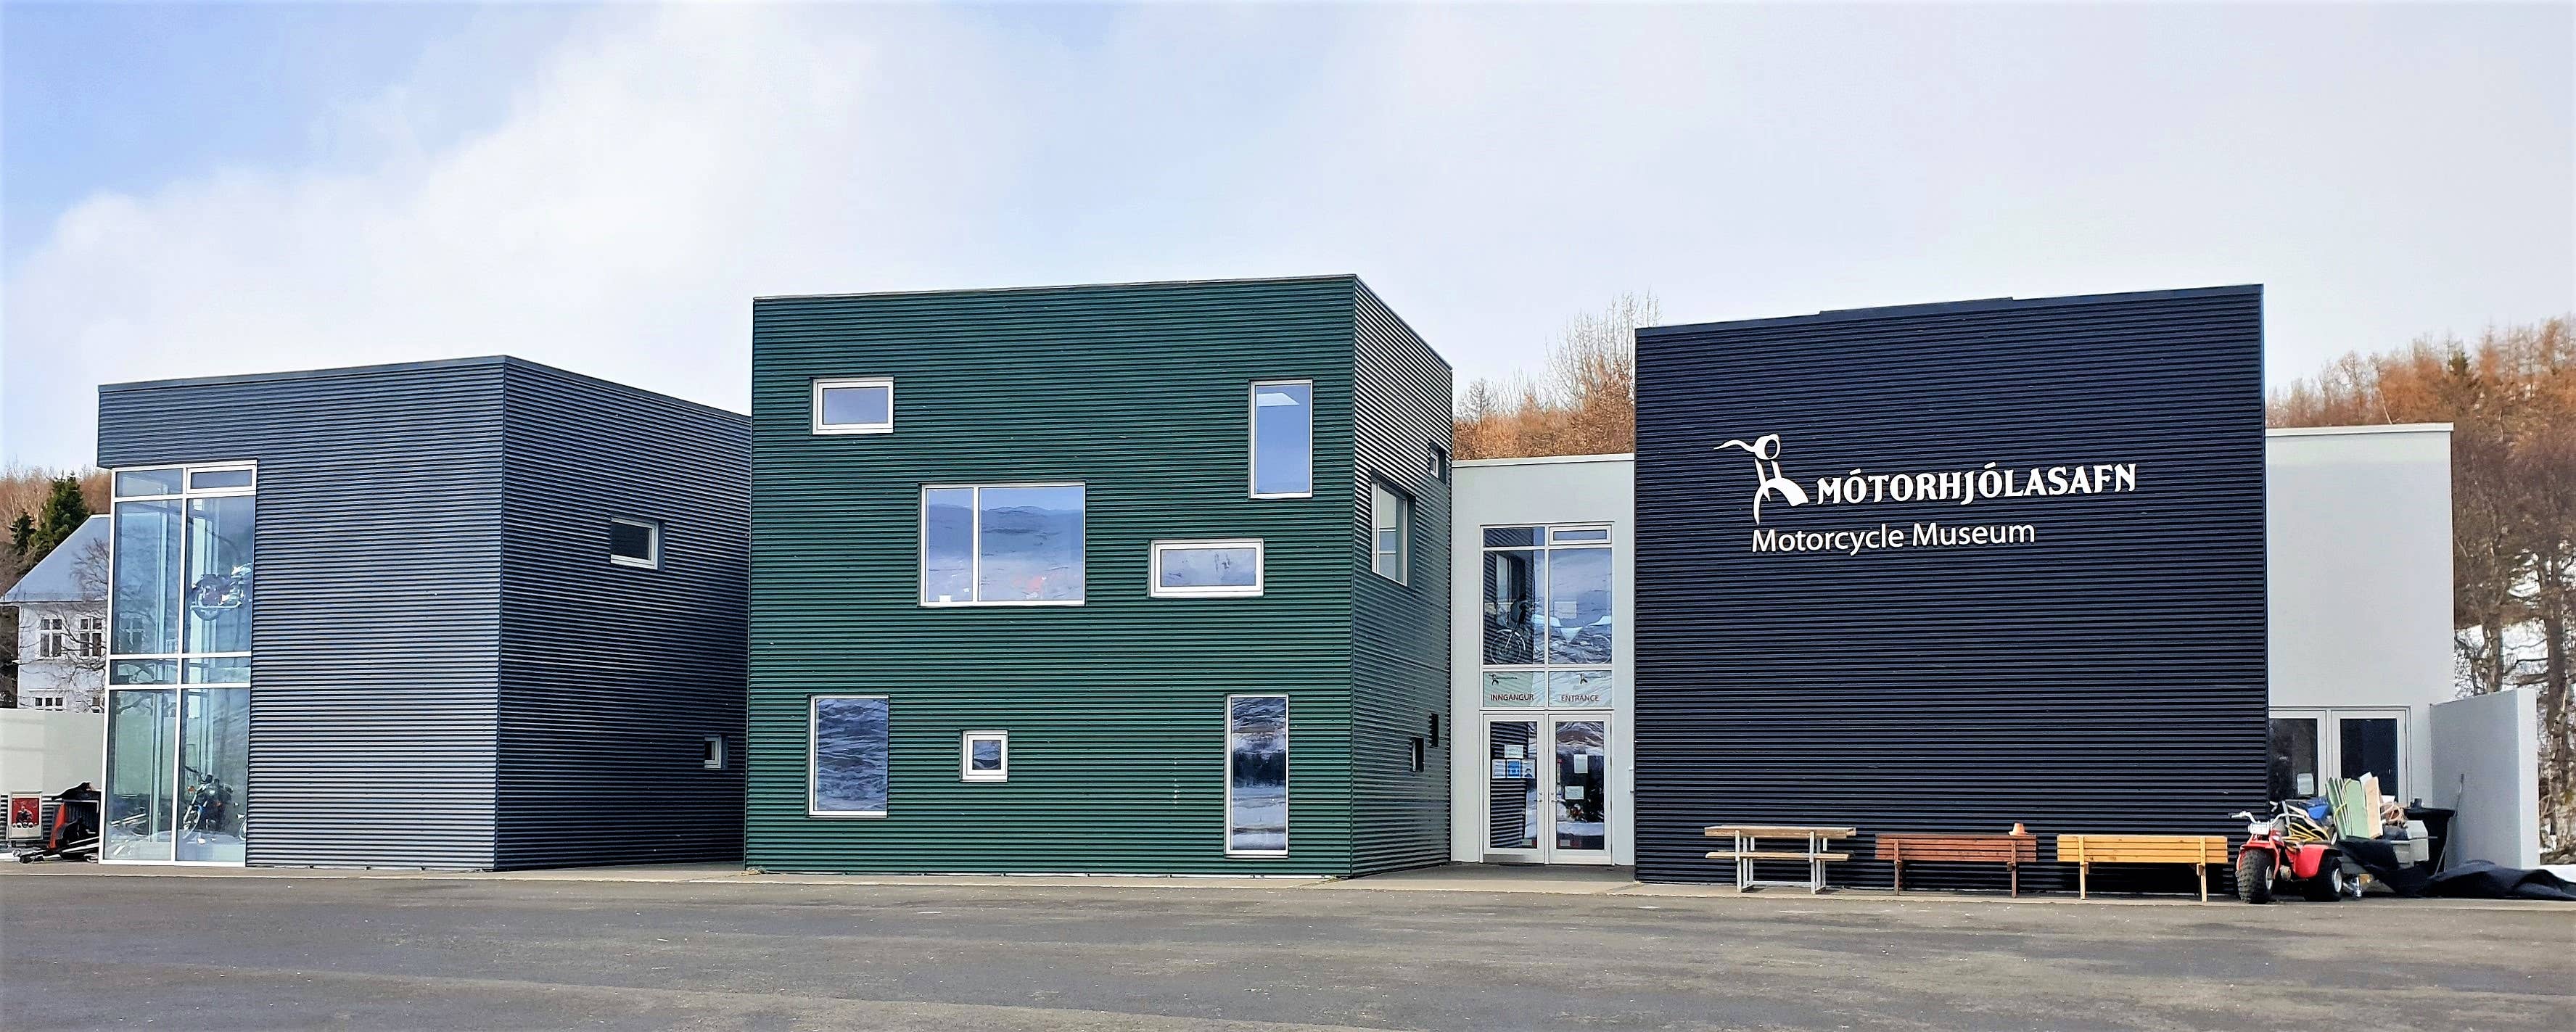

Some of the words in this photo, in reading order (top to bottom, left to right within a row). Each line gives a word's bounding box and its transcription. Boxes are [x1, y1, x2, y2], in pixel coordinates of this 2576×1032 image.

[1816, 461, 2137, 505] MÓTORHJÓLASAFN
[1751, 523, 1905, 557] Motorcycle
[1912, 521, 2036, 547] Museum
